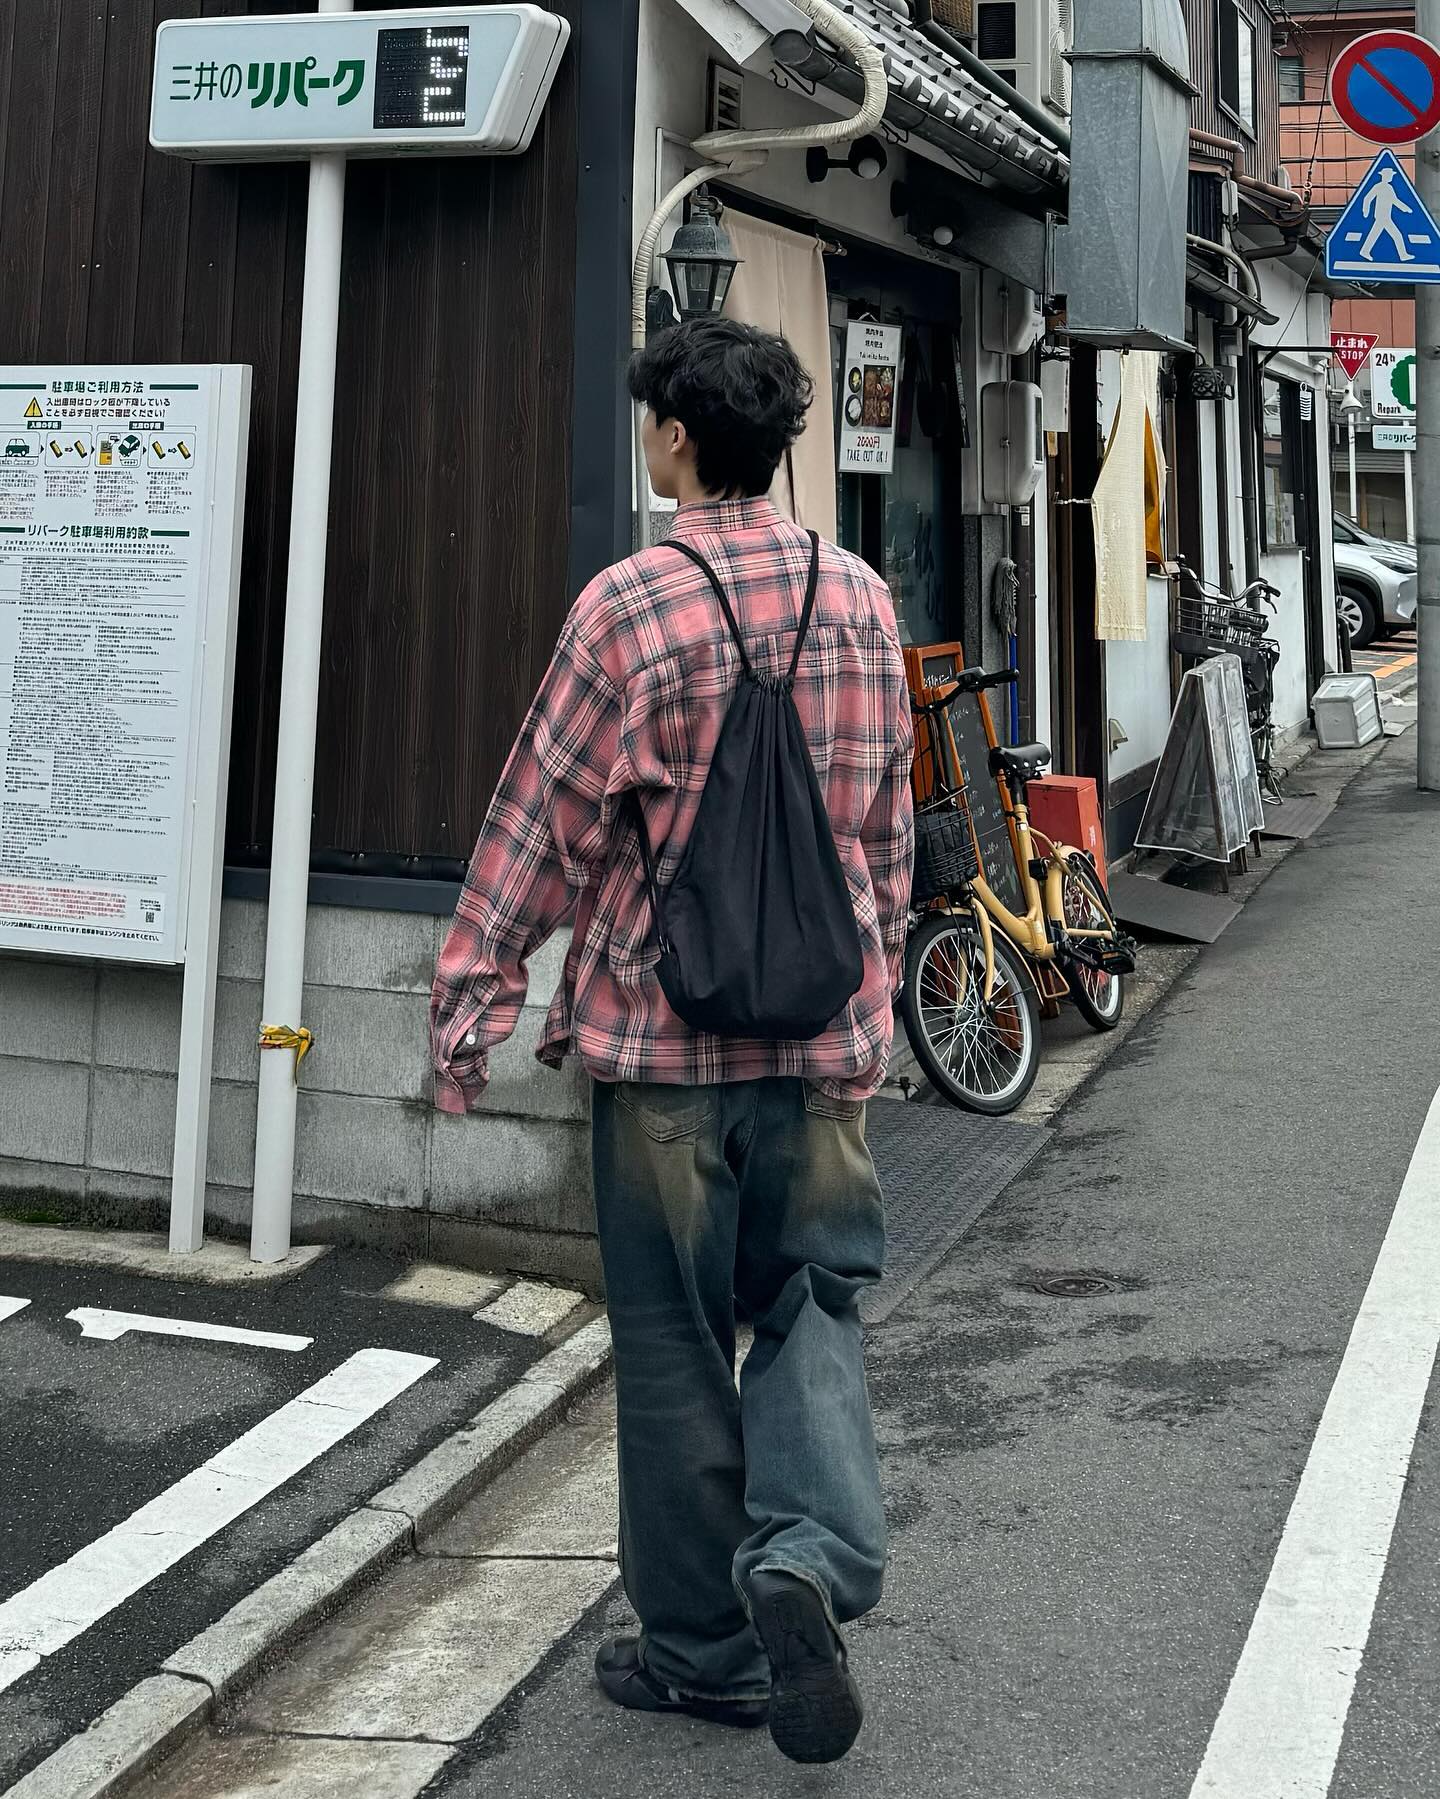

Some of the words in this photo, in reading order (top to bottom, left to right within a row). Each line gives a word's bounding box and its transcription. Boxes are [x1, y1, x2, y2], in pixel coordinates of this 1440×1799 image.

[170, 56, 365, 109] 三井のリパーク
[1335, 336, 1369, 348] 止まれ
[1341, 350, 1364, 360] STOP
[52, 381, 144, 393] 駐車場ご利用方法
[1377, 403, 1401, 414] Repark
[28, 524, 149, 540] リパーク駐車場利用約款
